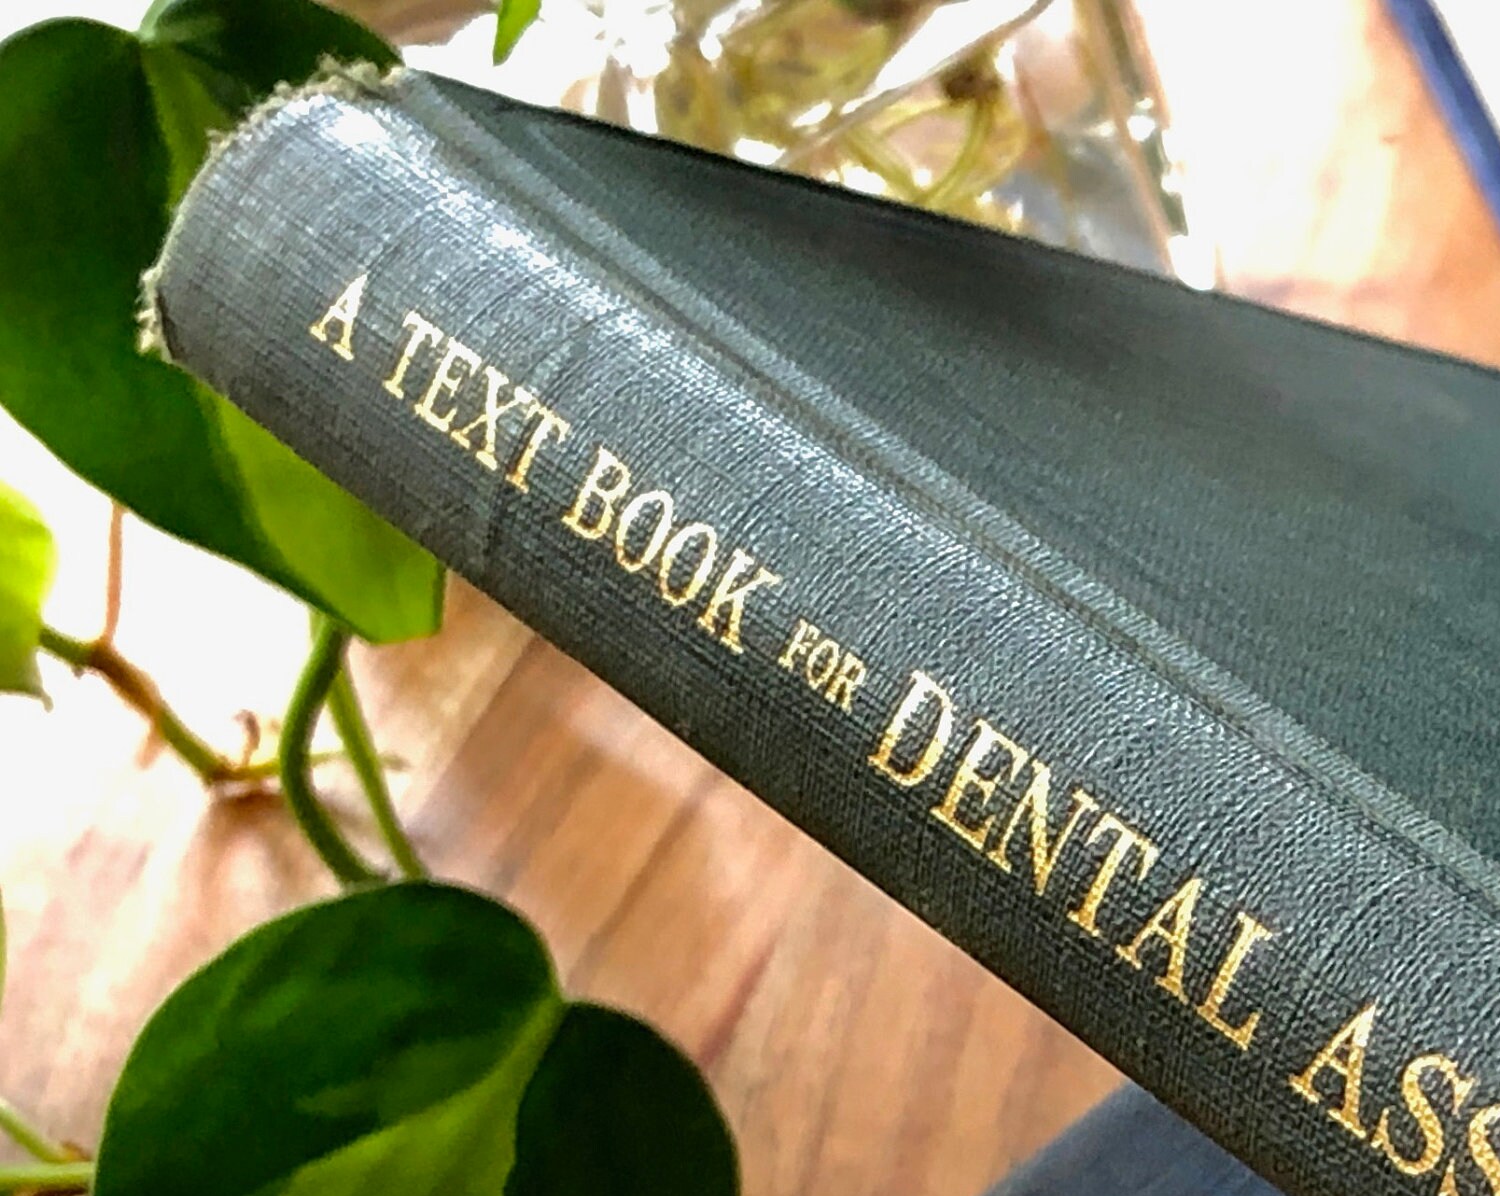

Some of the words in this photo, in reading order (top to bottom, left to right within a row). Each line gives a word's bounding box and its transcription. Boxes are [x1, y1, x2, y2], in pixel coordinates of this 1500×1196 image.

[312, 273, 368, 360] A
[384, 312, 568, 493] TEXT
[563, 447, 780, 653] BOOK
[779, 618, 864, 710] FOR
[868, 670, 1275, 1052] DENTAL
